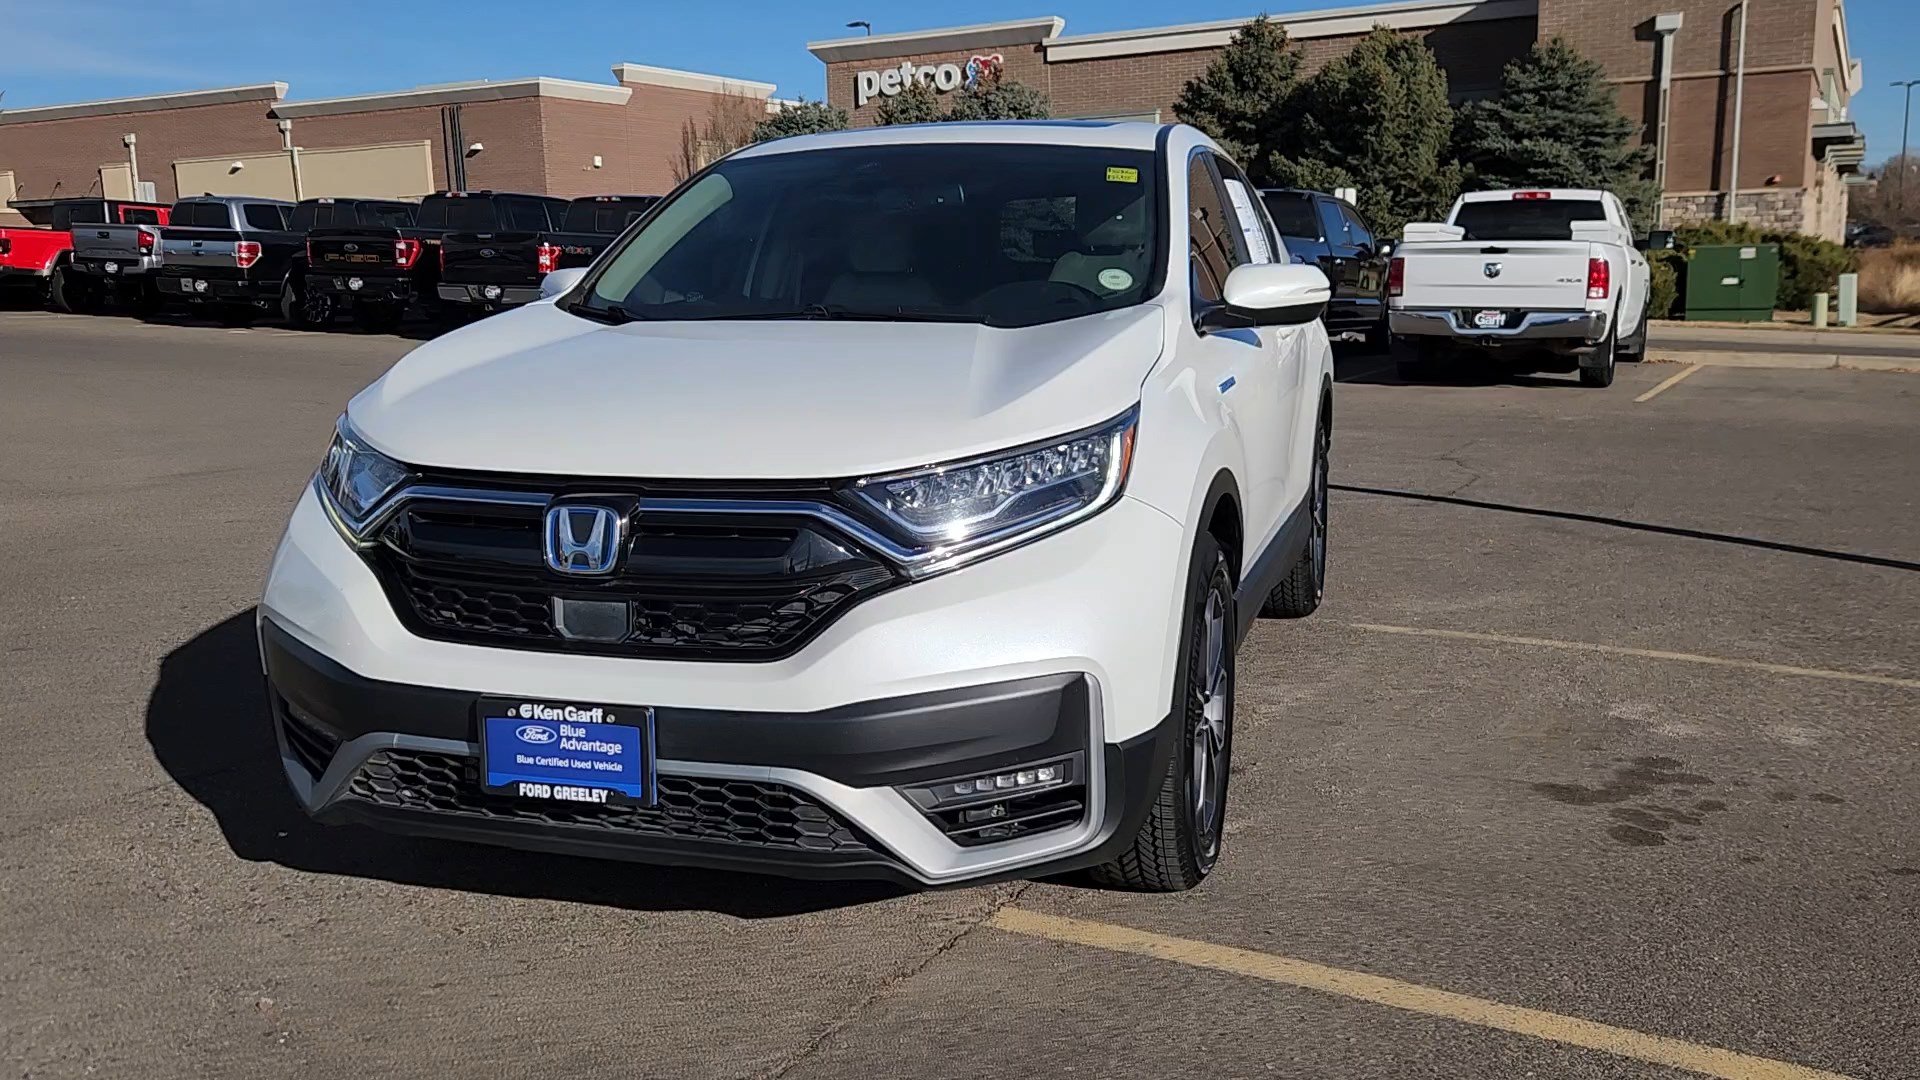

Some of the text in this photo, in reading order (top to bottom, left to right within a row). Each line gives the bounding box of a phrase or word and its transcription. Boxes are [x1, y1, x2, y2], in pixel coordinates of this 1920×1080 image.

[858, 61, 961, 106] petco
[523, 724, 586, 741] Ford Blue
[560, 738, 622, 755] Advantage
[516, 754, 623, 773] Blue Certified Used Vehicle
[519, 782, 608, 803] FORD GREELEY
